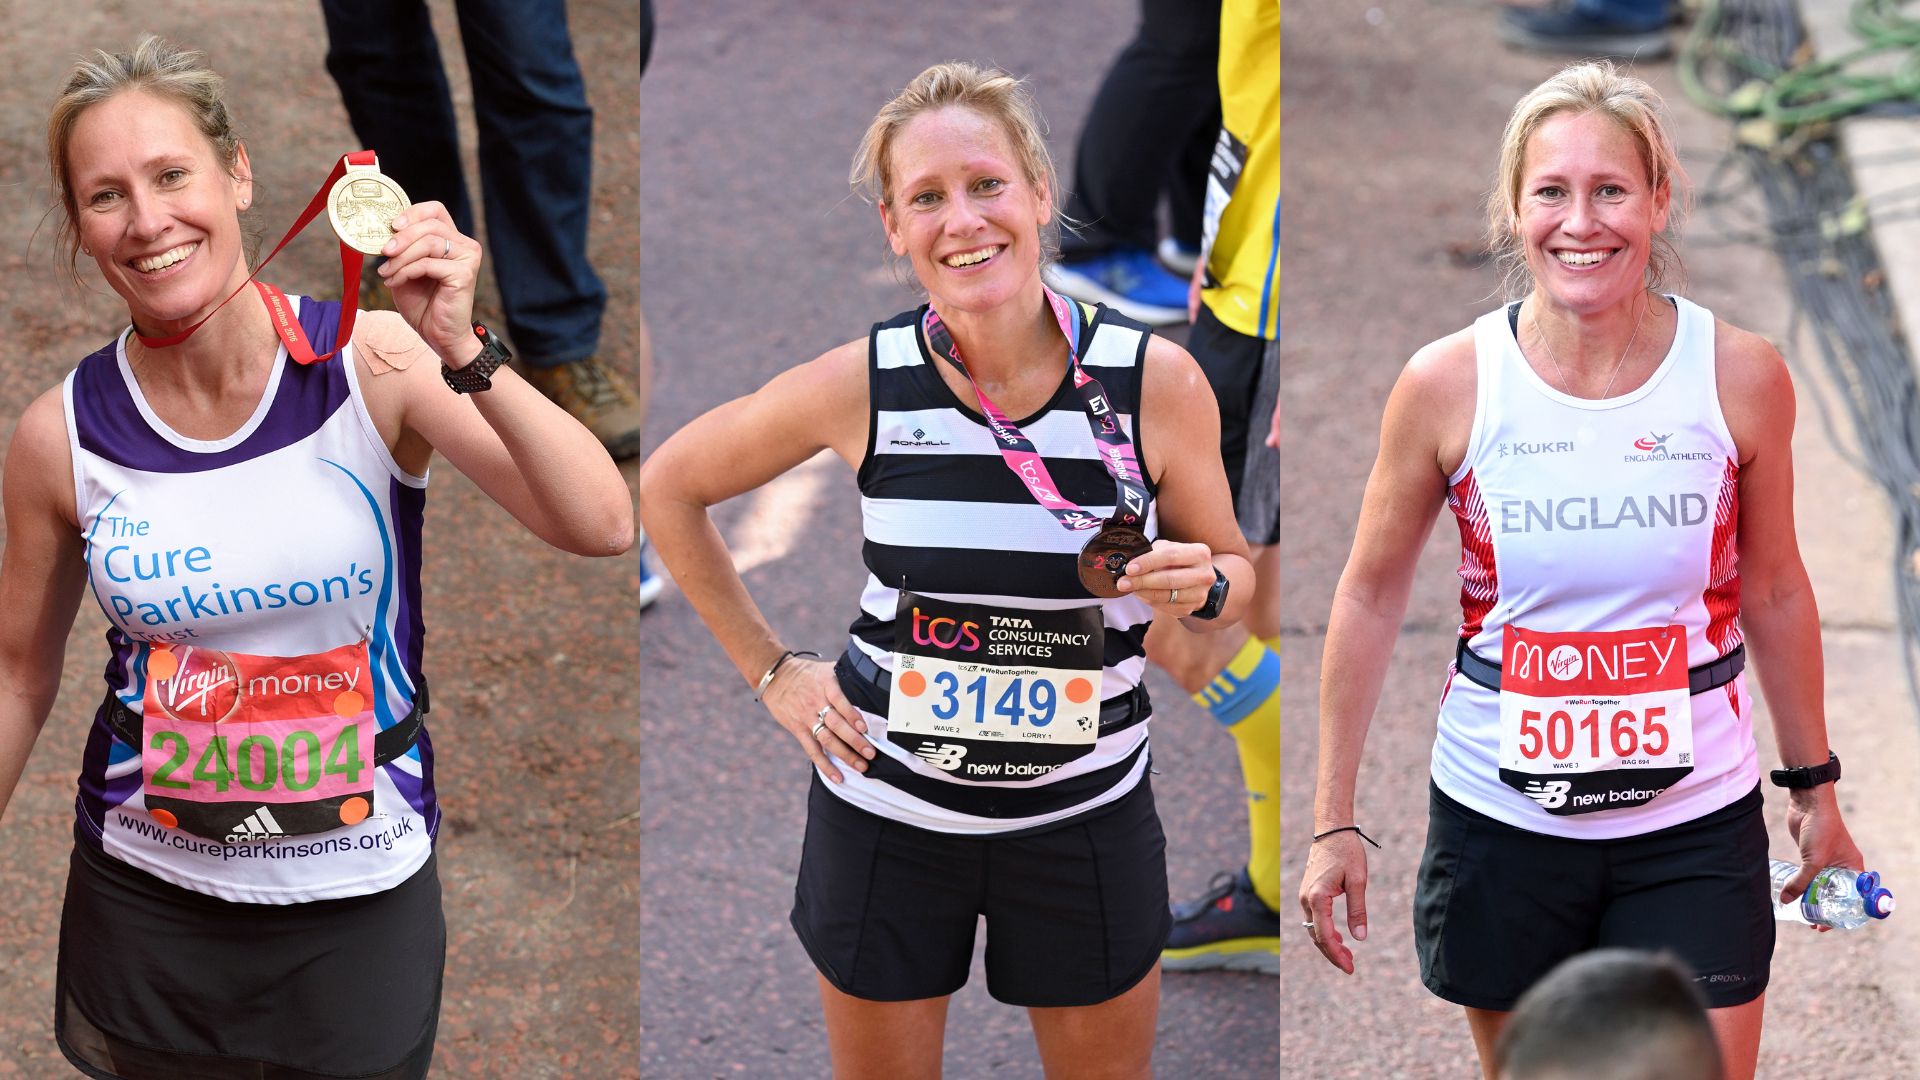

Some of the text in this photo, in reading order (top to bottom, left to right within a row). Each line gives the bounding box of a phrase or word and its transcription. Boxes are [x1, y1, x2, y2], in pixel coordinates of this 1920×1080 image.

[270, 295, 288, 327] Marathon
[1513, 441, 1574, 455] KUKRI
[1624, 453, 1713, 463] ENGLAND ATHLETICS
[1020, 459, 1040, 485] tcs
[1109, 447, 1131, 481] FINISHER
[1501, 493, 1707, 534] ENGLAND
[108, 516, 150, 538] The
[104, 545, 212, 583] Cure
[110, 562, 373, 626] Parkinson's
[132, 627, 199, 642] Trust
[912, 607, 980, 651] tcs
[989, 616, 1033, 629] TATA
[988, 630, 1091, 646] CONSULTANCY
[988, 644, 1052, 658] SERVICES
[981, 667, 1038, 676] #WeRunTogether
[1551, 650, 1579, 675] Virgin
[161, 645, 360, 716] Virgin money
[931, 671, 1057, 727] 3149
[1519, 706, 1669, 760] 50165
[150, 724, 365, 793] 24004
[967, 763, 1001, 775] new
[1573, 793, 1606, 806] new
[118, 813, 413, 861] www.cureparkinsons.org.uk
